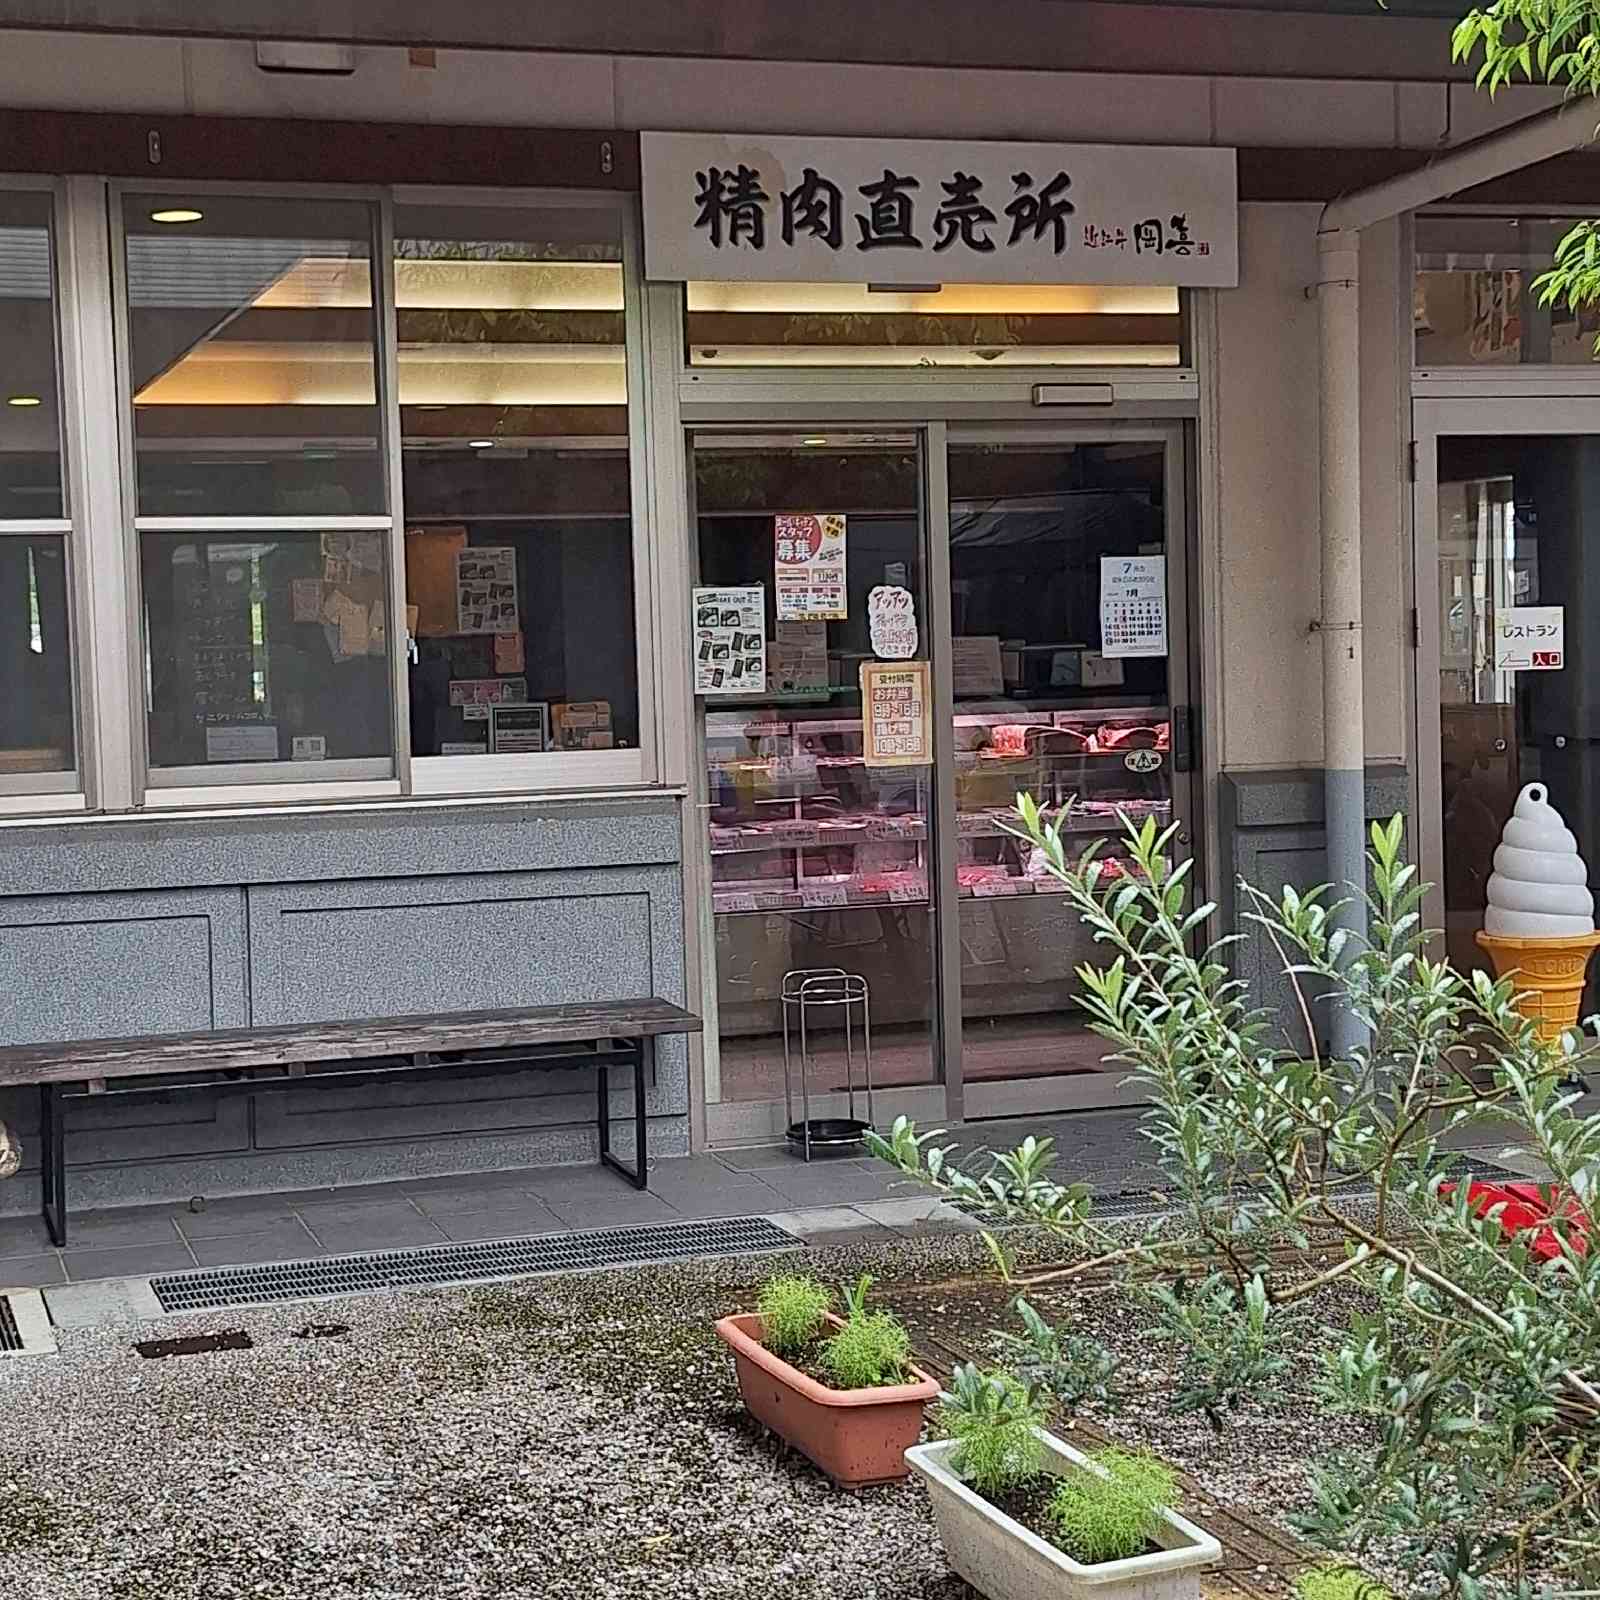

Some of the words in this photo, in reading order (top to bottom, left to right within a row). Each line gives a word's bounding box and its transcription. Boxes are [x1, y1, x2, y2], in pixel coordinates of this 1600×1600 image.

[693, 163, 1076, 255] 精肉直売所
[777, 539, 812, 561] 募集
[1503, 624, 1558, 638] レストラン
[1534, 652, 1561, 667] 入口
[879, 673, 915, 685] 受付時間
[874, 689, 910, 700] お弁当
